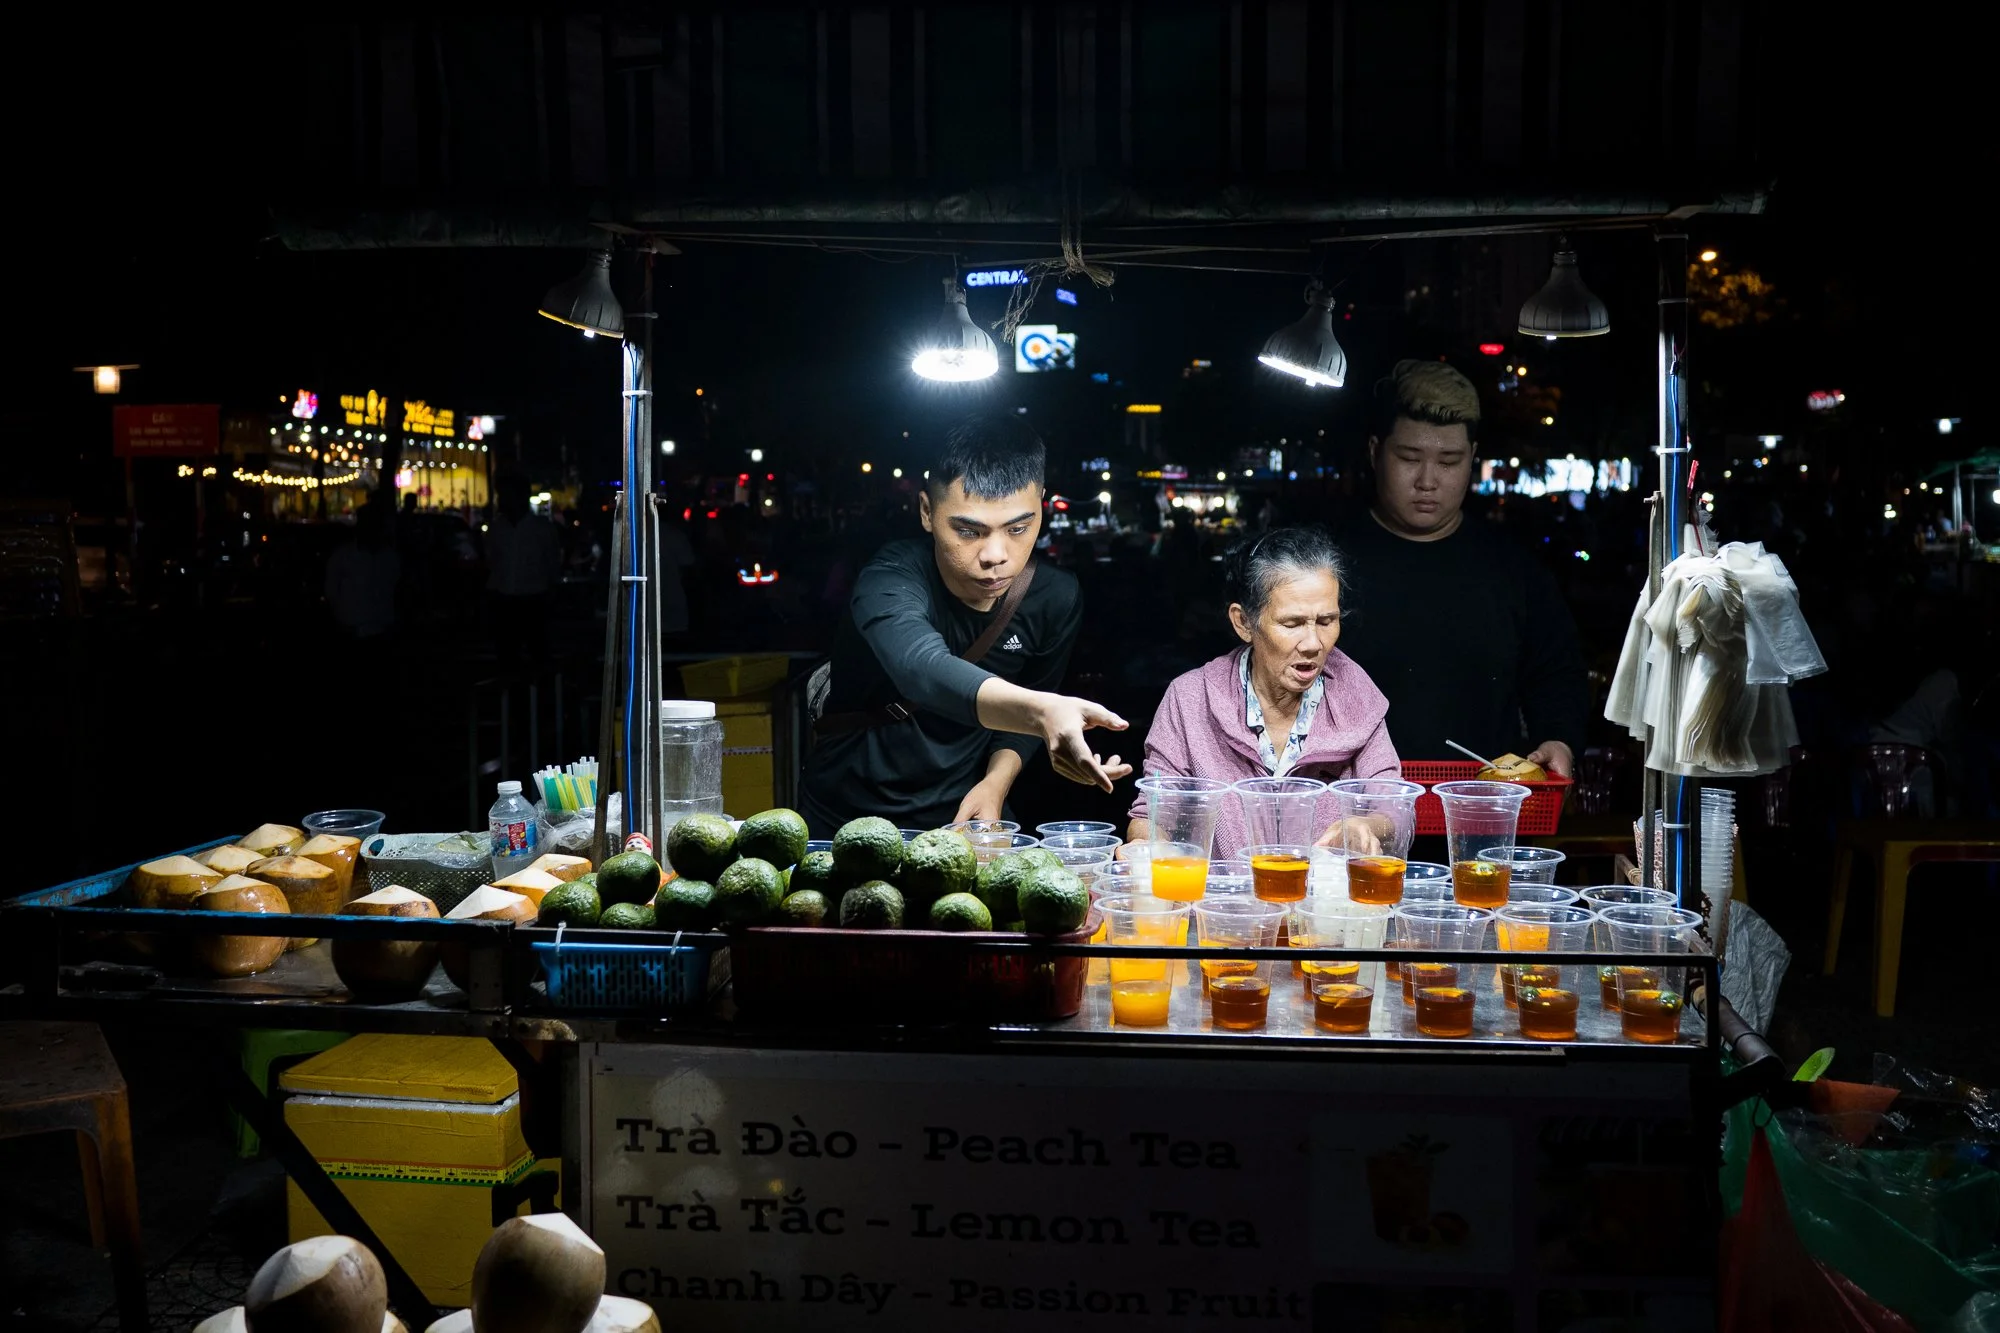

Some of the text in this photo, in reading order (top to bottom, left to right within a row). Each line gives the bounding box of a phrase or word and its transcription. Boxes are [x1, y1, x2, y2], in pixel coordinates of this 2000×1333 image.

[616, 1112, 721, 1156] Trà
[742, 1114, 858, 1159] Đào
[923, 1126, 1111, 1167] Peach
[1129, 1131, 1242, 1170] Tea
[616, 1189, 722, 1233] Trà
[740, 1187, 845, 1236] Tắc
[910, 1203, 1130, 1245] Lemon
[1149, 1209, 1261, 1249] Tea
[617, 1266, 787, 1302] Chanh
[800, 1272, 897, 1316] Dây
[948, 1278, 1151, 1316] Passion
[1166, 1285, 1307, 1322] Fruit
